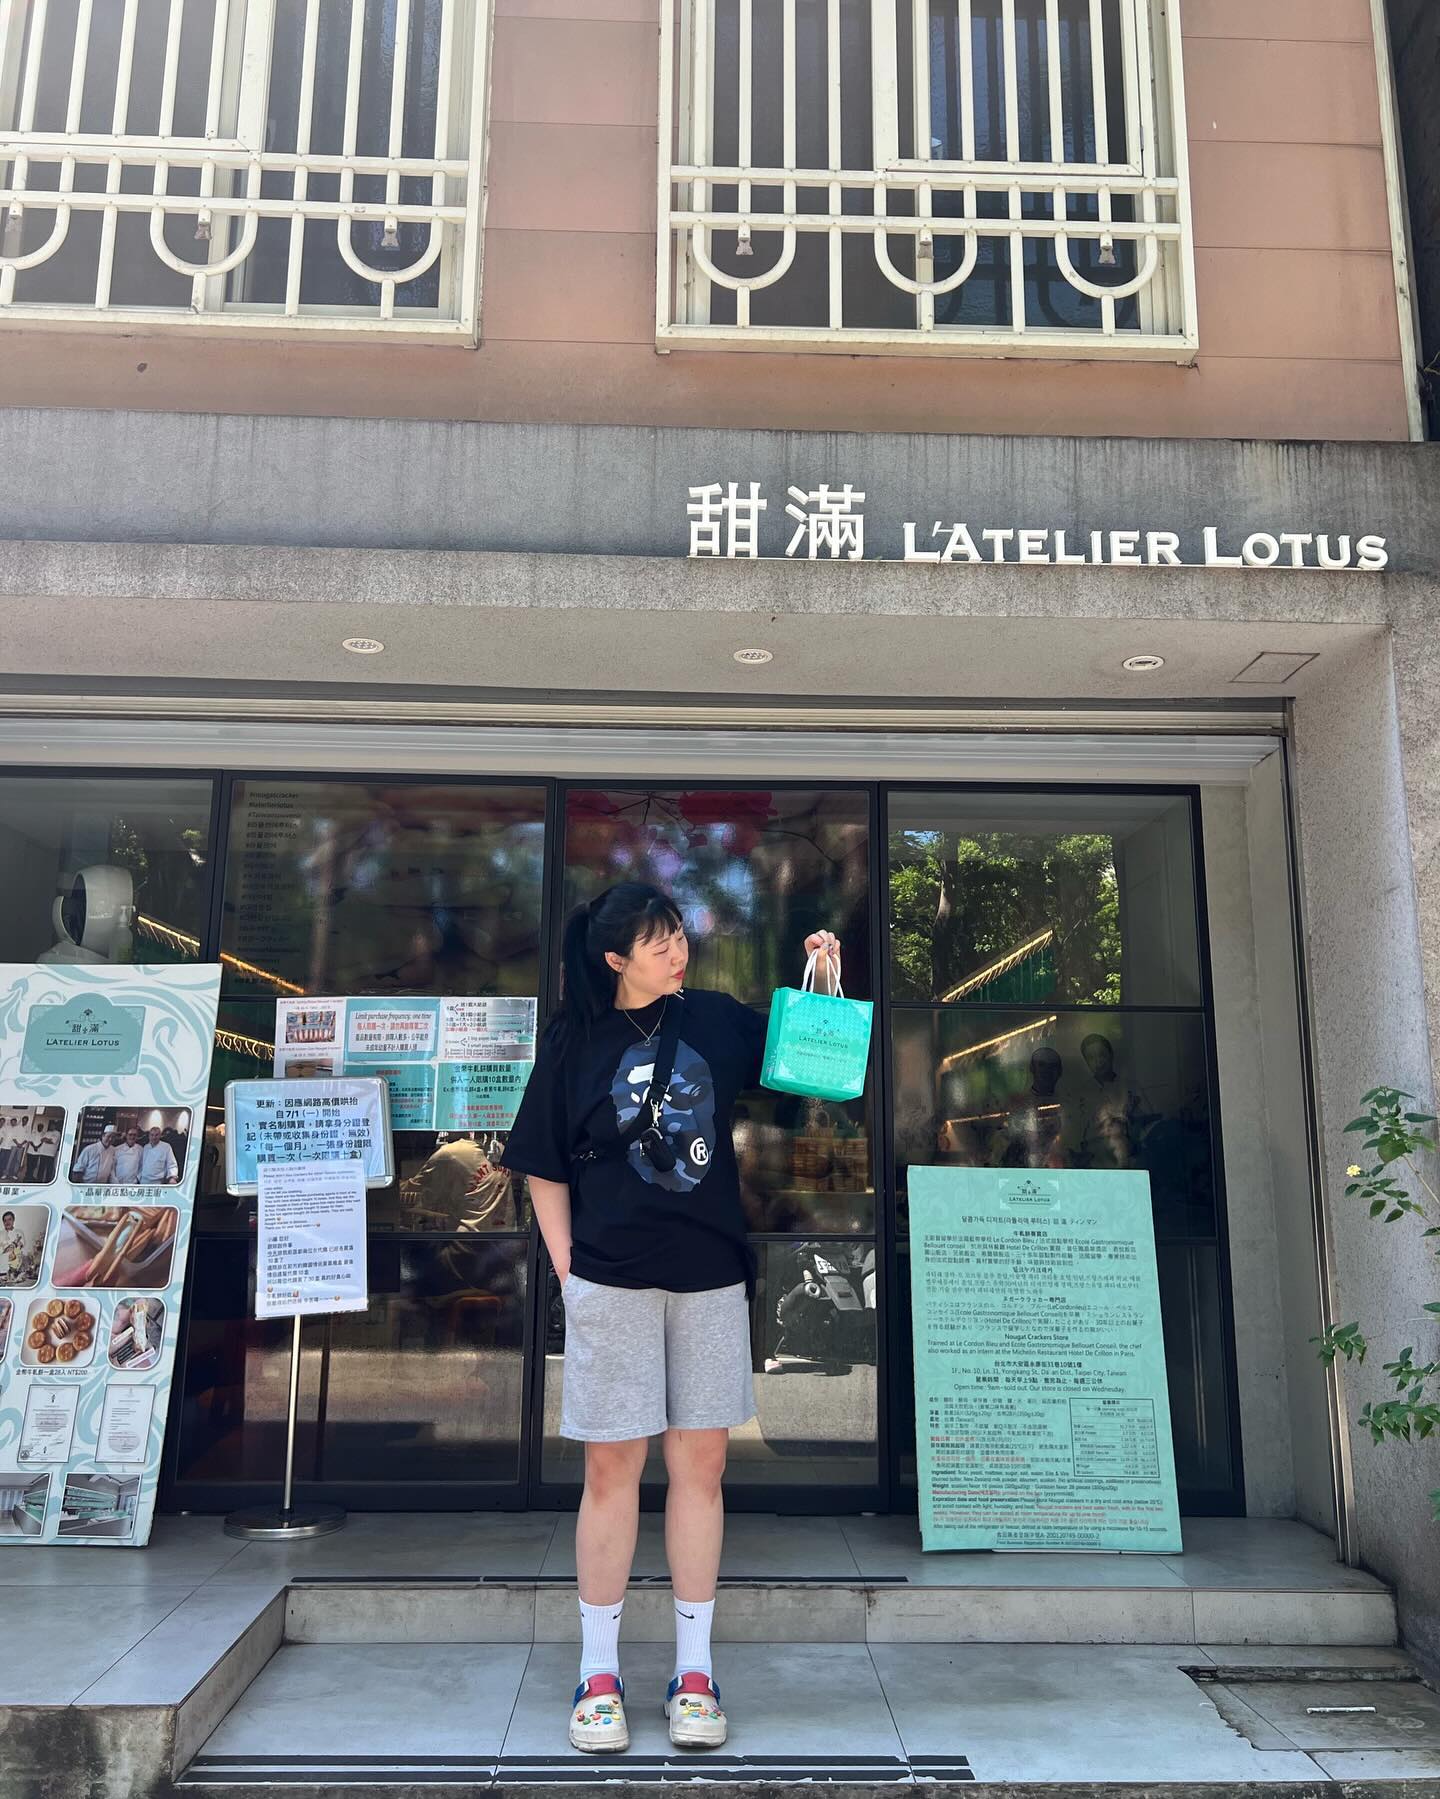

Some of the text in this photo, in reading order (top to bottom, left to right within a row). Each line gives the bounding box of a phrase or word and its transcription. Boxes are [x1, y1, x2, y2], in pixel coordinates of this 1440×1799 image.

[687, 482, 866, 559] 甜滿
[902, 521, 1389, 569] L'ATELIER LOTUS
